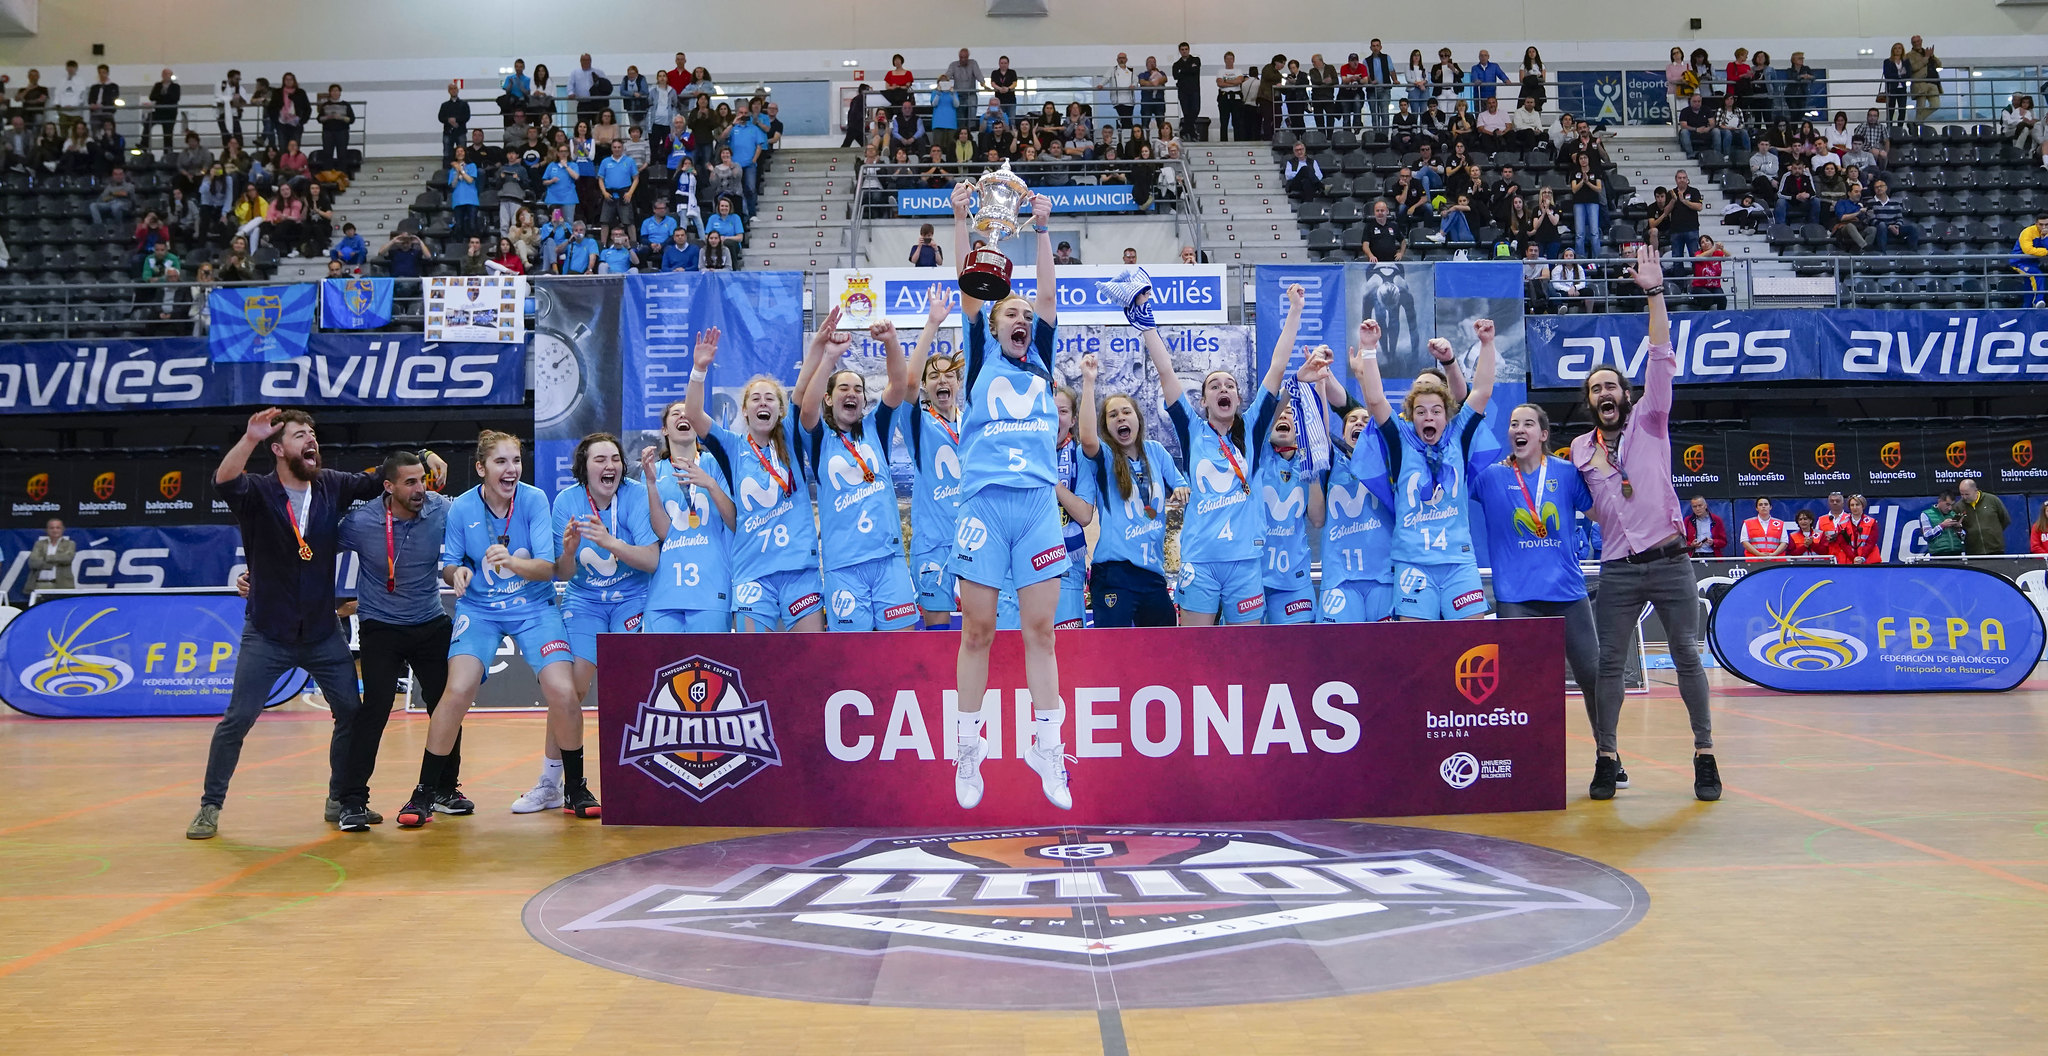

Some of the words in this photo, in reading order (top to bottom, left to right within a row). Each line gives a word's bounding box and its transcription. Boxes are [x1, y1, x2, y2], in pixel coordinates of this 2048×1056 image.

[1629, 91, 1642, 99] en
[1073, 193, 1136, 206] MUNICIP
[1110, 337, 1140, 352] en
[1167, 329, 1220, 352] vilés
[1557, 317, 1791, 381] avlés
[261, 341, 500, 400] avilés
[984, 417, 1049, 437] Estudiantes
[1008, 447, 1026, 472] 5
[1672, 473, 1719, 483] baloncesto
[1738, 472, 1785, 482] baloncesto
[1803, 471, 1851, 481] baloncesto
[1869, 470, 1916, 480] baloncesto
[1935, 468, 1982, 479] baloncesto
[2000, 467, 2048, 478] baloncesto
[12, 501, 61, 512] baloncesto
[78, 500, 127, 511] baloncesto
[145, 499, 194, 510] baloncesto
[834, 480, 886, 513] Estudiantes
[1197, 491, 1247, 516] Estudiantes
[744, 499, 794, 534] Estudiantes
[857, 510, 873, 533] 6
[1404, 504, 1458, 528] Estudiantes
[757, 523, 790, 553] 78
[957, 516, 988, 551] hp
[1217, 518, 1233, 541] 4
[1329, 516, 1382, 541] Estudiantes
[1420, 527, 1448, 551] 14
[662, 533, 709, 552] studiantes
[1518, 538, 1562, 549] movistar
[1267, 547, 1290, 573] 10
[1342, 548, 1364, 572] 11
[672, 562, 700, 587] 13
[736, 581, 763, 604] hp
[1322, 588, 1347, 615] hp
[831, 589, 856, 618] hp
[1877, 616, 2006, 650] FBPA
[144, 641, 233, 673] FBP
[1880, 654, 1934, 664] FEDERACIÓN
[1937, 655, 1949, 664] DE
[1951, 656, 2010, 665] BALONCESTO
[661, 663, 692, 678] CAMPEONATO
[712, 666, 733, 678] ESPAÑA
[1895, 664, 1942, 675] Principado
[1945, 666, 1957, 674] de
[1959, 666, 1996, 675] Asturias
[194, 678, 207, 686] DE
[1426, 707, 1528, 728] baloncesto
[629, 712, 772, 752] JUNIOR
[1427, 729, 1470, 739] ESPAÑA
[684, 761, 718, 769] FEMENINO
[713, 764, 733, 779] 2019
[1481, 766, 1511, 774] MUJER
[892, 830, 1040, 845] CAMPEONATO
[1151, 830, 1245, 839] ESPAÑA
[644, 858, 1529, 913] JUNIOR
[991, 913, 1206, 927] FEMENINO
